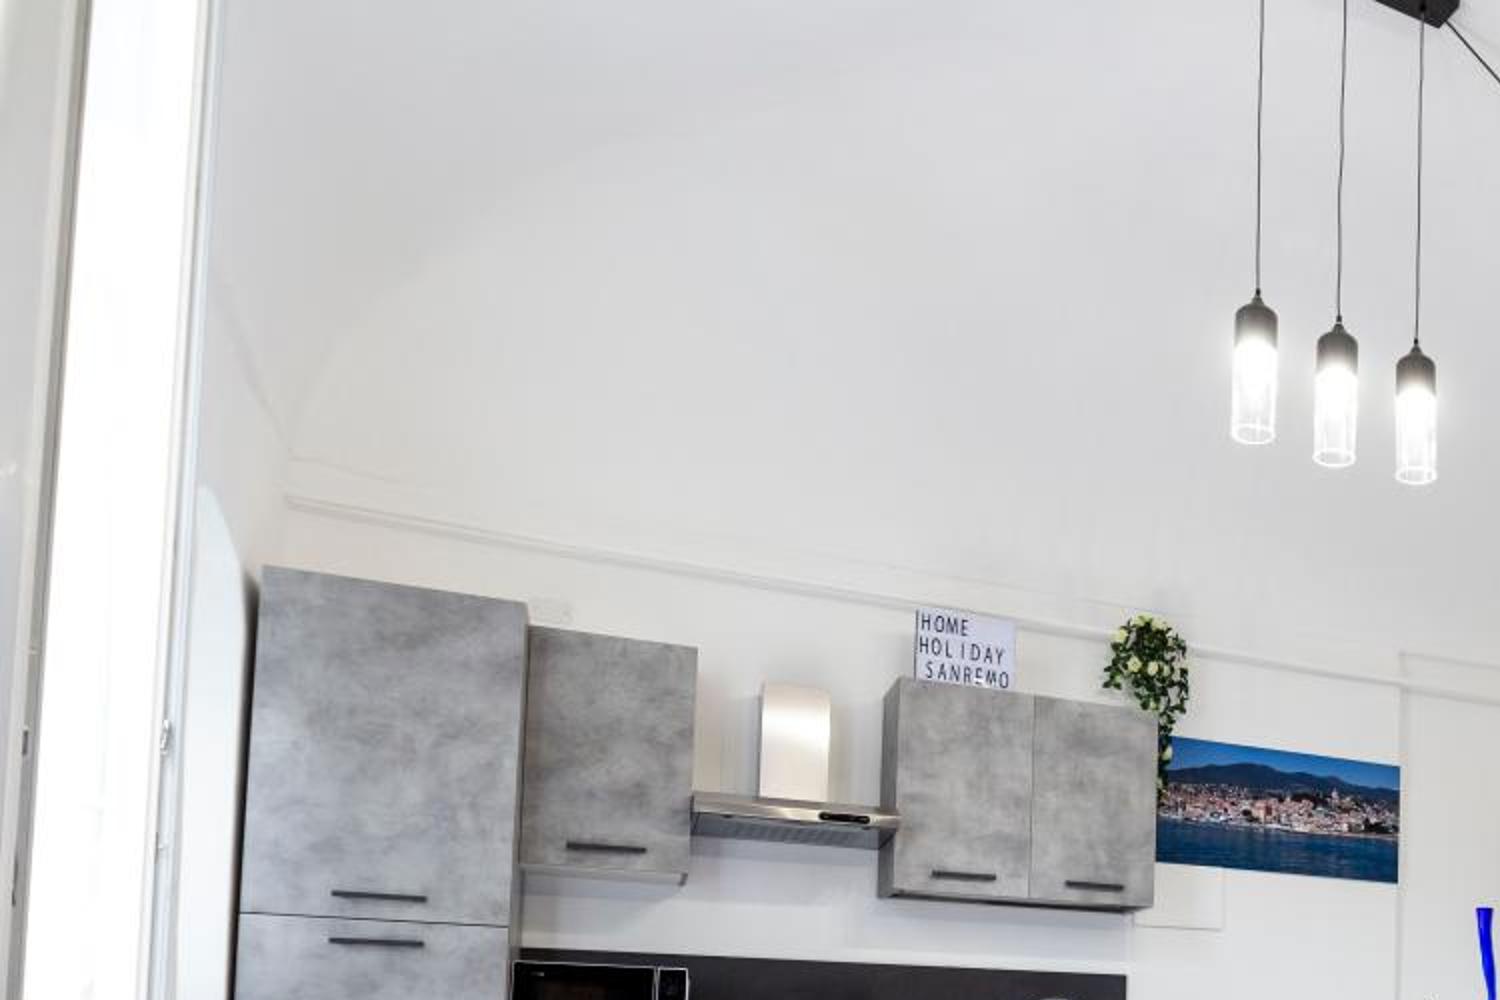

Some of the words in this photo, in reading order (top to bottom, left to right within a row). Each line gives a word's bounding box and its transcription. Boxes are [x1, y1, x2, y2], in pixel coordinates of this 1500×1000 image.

[921, 612, 969, 637] HOME
[919, 636, 1005, 665] HOLIDAY
[925, 660, 1010, 689] SANREMO
